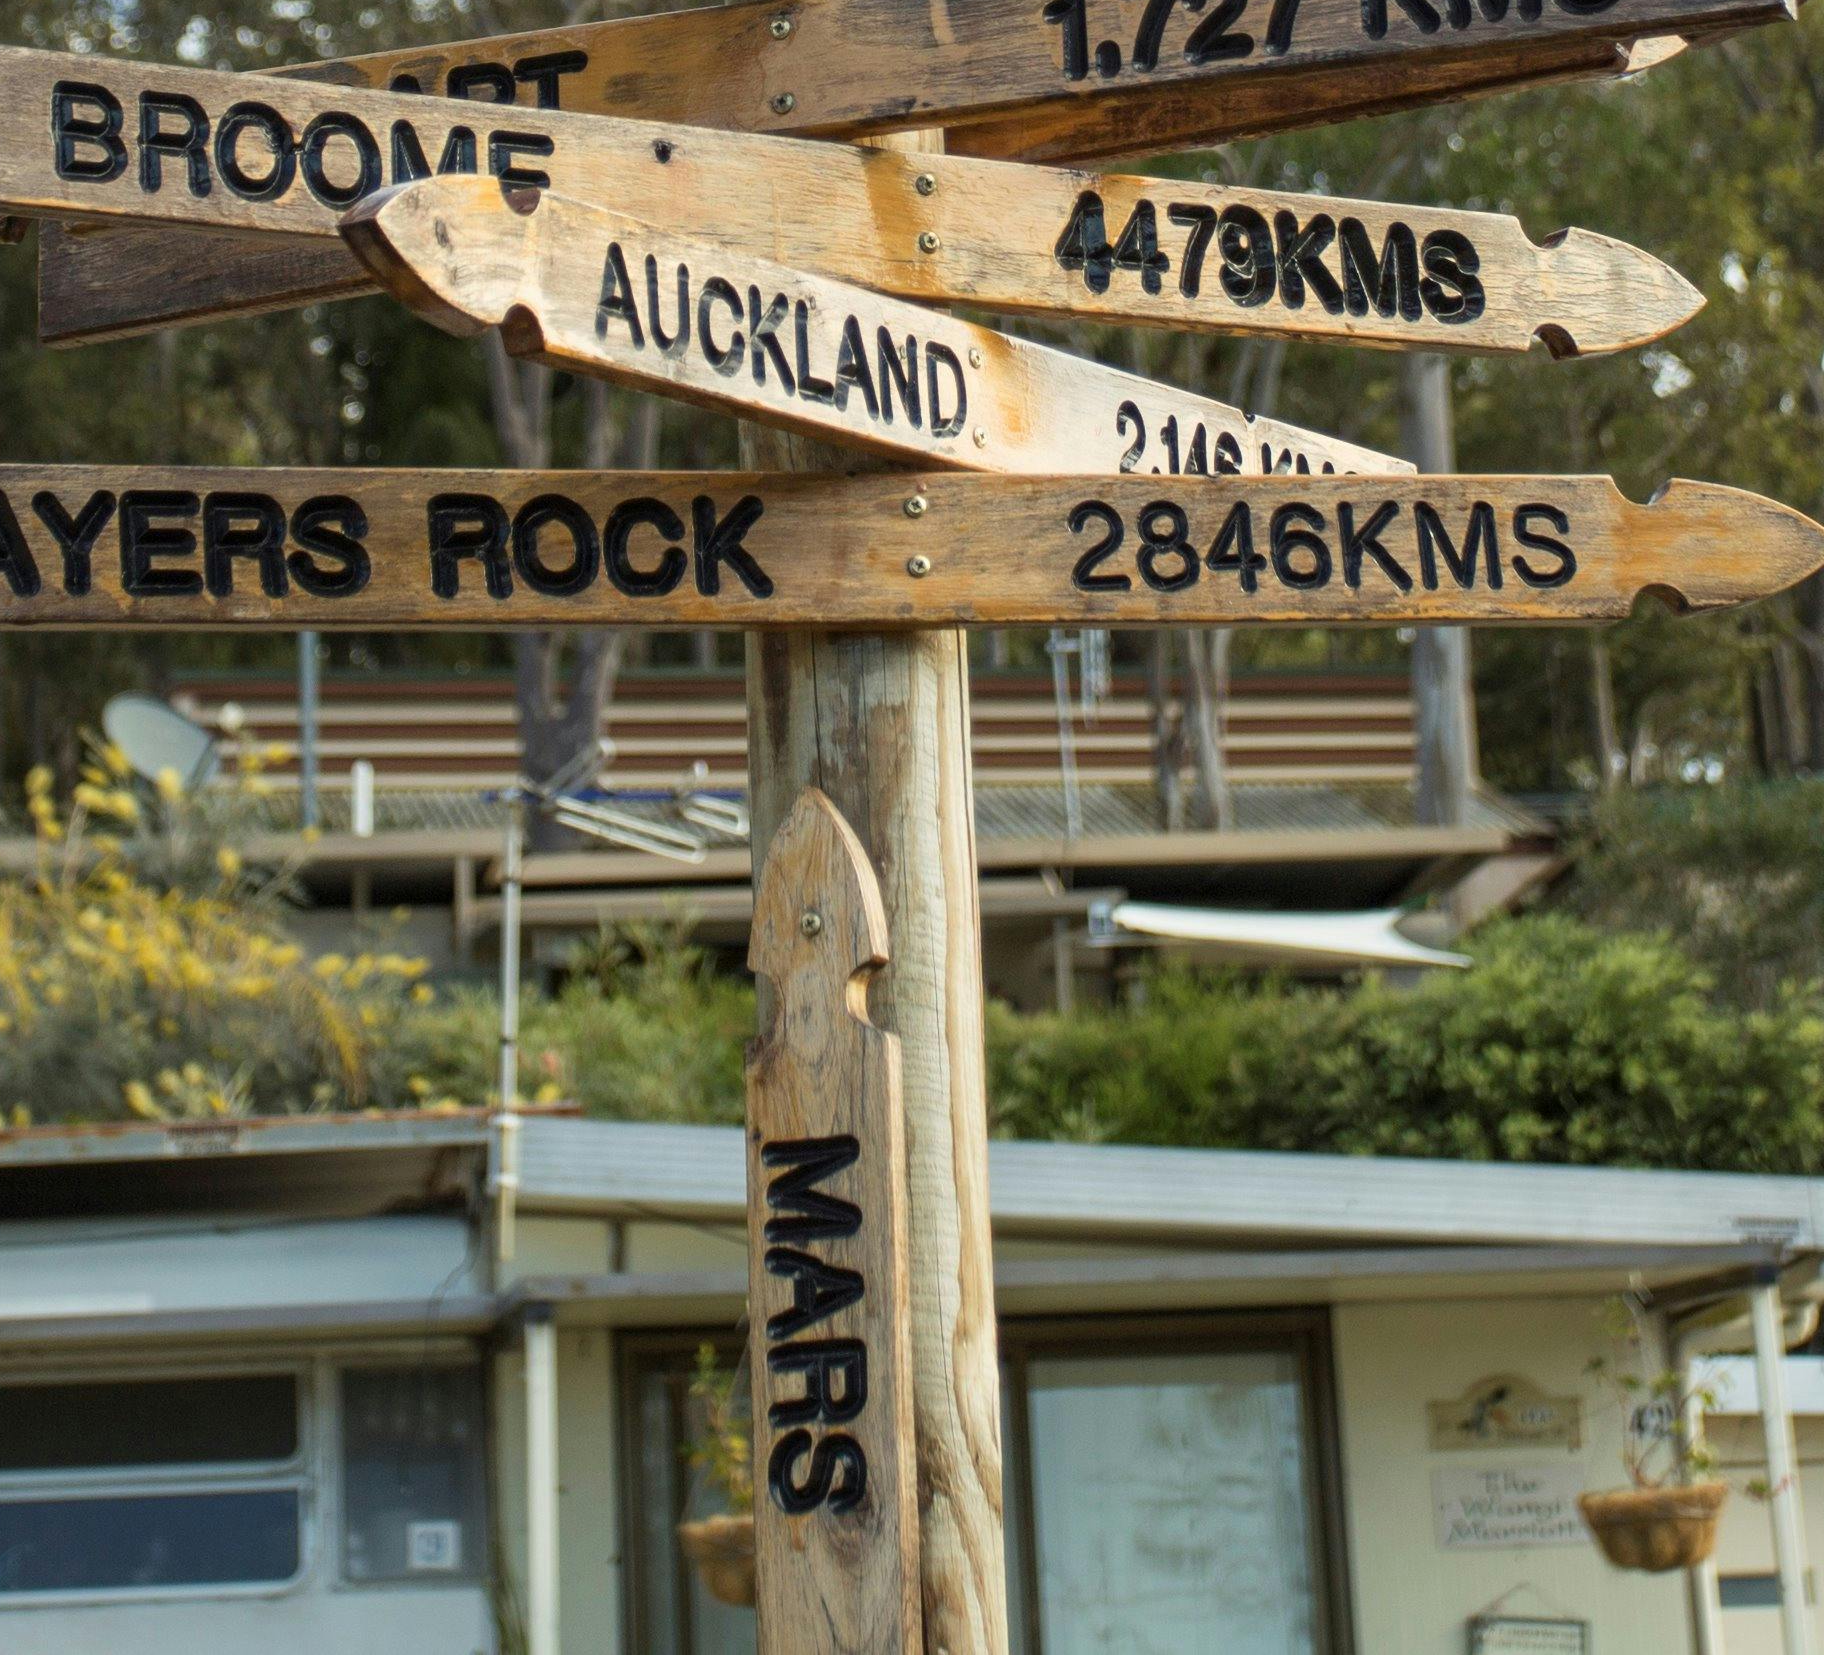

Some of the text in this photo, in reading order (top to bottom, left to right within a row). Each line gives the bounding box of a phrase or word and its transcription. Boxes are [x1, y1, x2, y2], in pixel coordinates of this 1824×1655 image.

[51, 79, 555, 211] BROOME
[1053, 188, 1486, 325] 4479KMS
[595, 241, 969, 439] AUCKLAND
[427, 491, 775, 600] ROCK
[1065, 498, 1577, 592] 2846KMS
[761, 1133, 868, 1516] MARS
